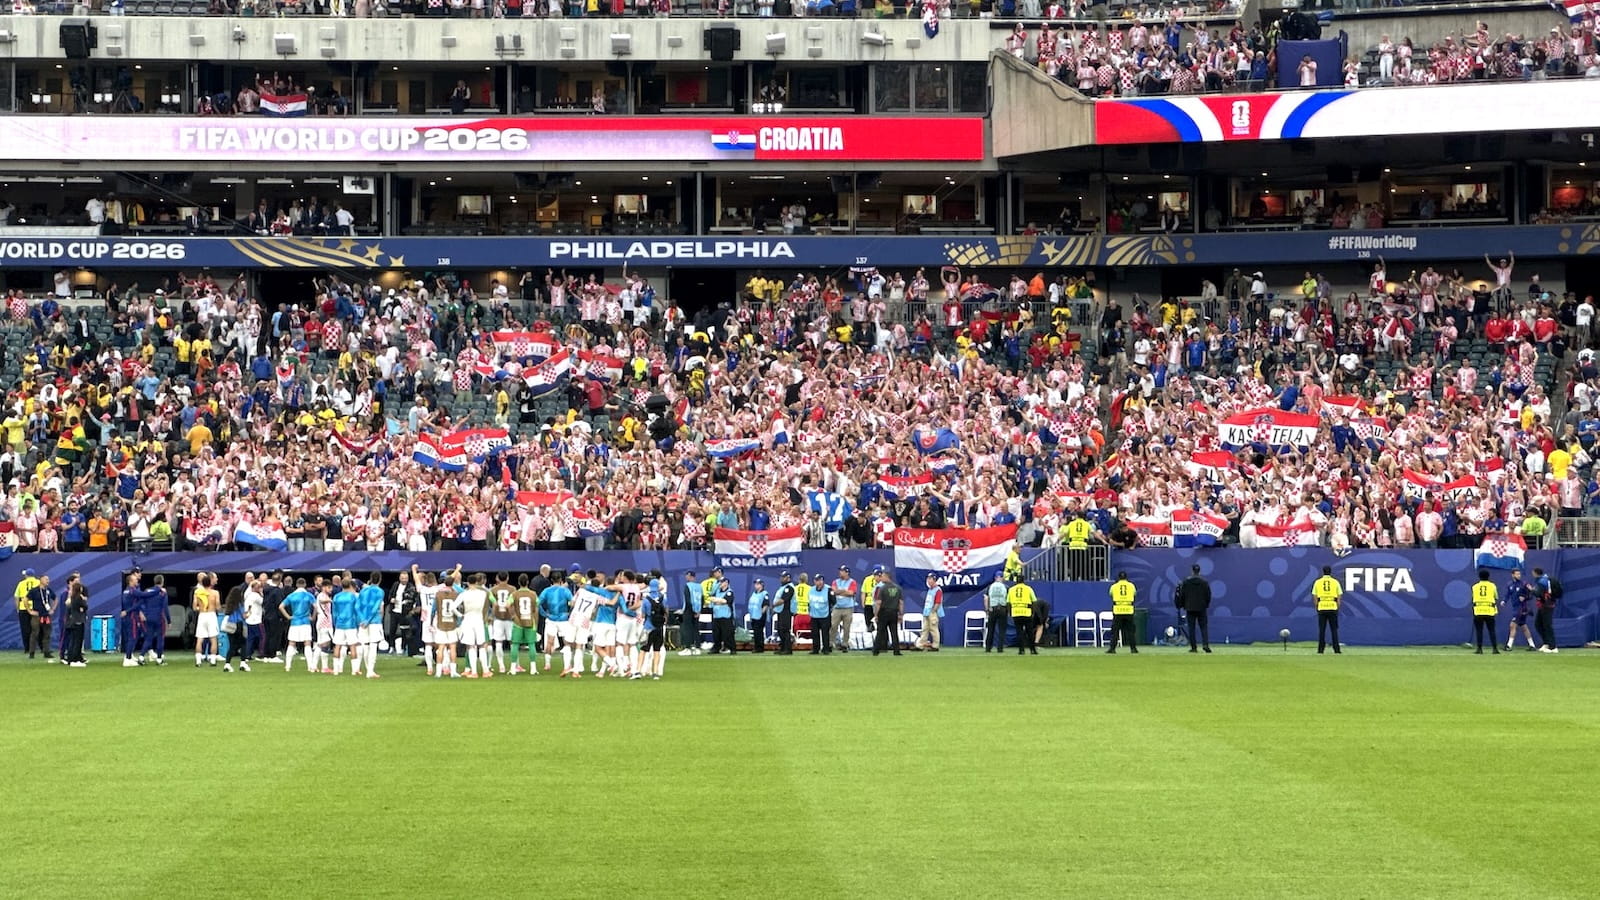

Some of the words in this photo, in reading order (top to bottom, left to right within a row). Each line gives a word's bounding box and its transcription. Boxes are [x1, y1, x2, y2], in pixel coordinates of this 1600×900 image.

[179, 128, 243, 150] FIFA
[247, 128, 356, 150] WORLD
[360, 128, 419, 150] CUP
[424, 128, 527, 150] 2026
[760, 127, 844, 150] CROATIA
[549, 242, 795, 258] PHILADELPHIA
[1328, 235, 1417, 250] #FIFAWorldCup
[0, 243, 64, 259] ORLD
[68, 243, 109, 259] CUP
[113, 243, 185, 259] 2026
[721, 556, 798, 567] KOMARNA
[927, 573, 981, 589] AVTAT
[1345, 568, 1416, 592] FIFA
[578, 598, 592, 613] 17
